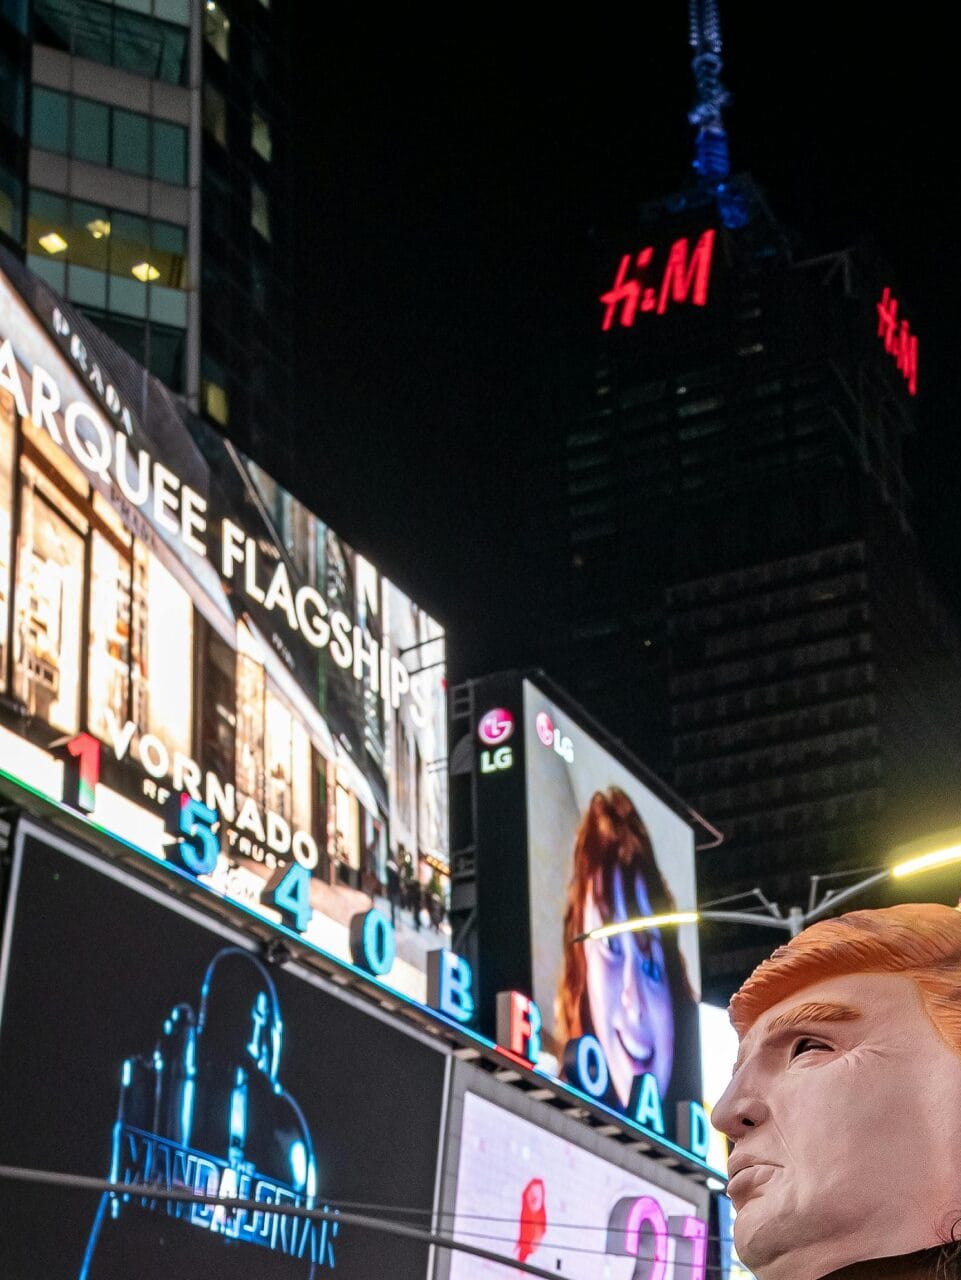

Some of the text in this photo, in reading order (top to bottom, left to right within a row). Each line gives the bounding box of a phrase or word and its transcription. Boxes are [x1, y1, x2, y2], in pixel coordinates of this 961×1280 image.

[600, 229, 715, 331] H&M
[104, 706, 319, 870] VORNADO
[480, 746, 513, 774] LG
[553, 728, 575, 763] LG
[66, 732, 396, 977] 1540
